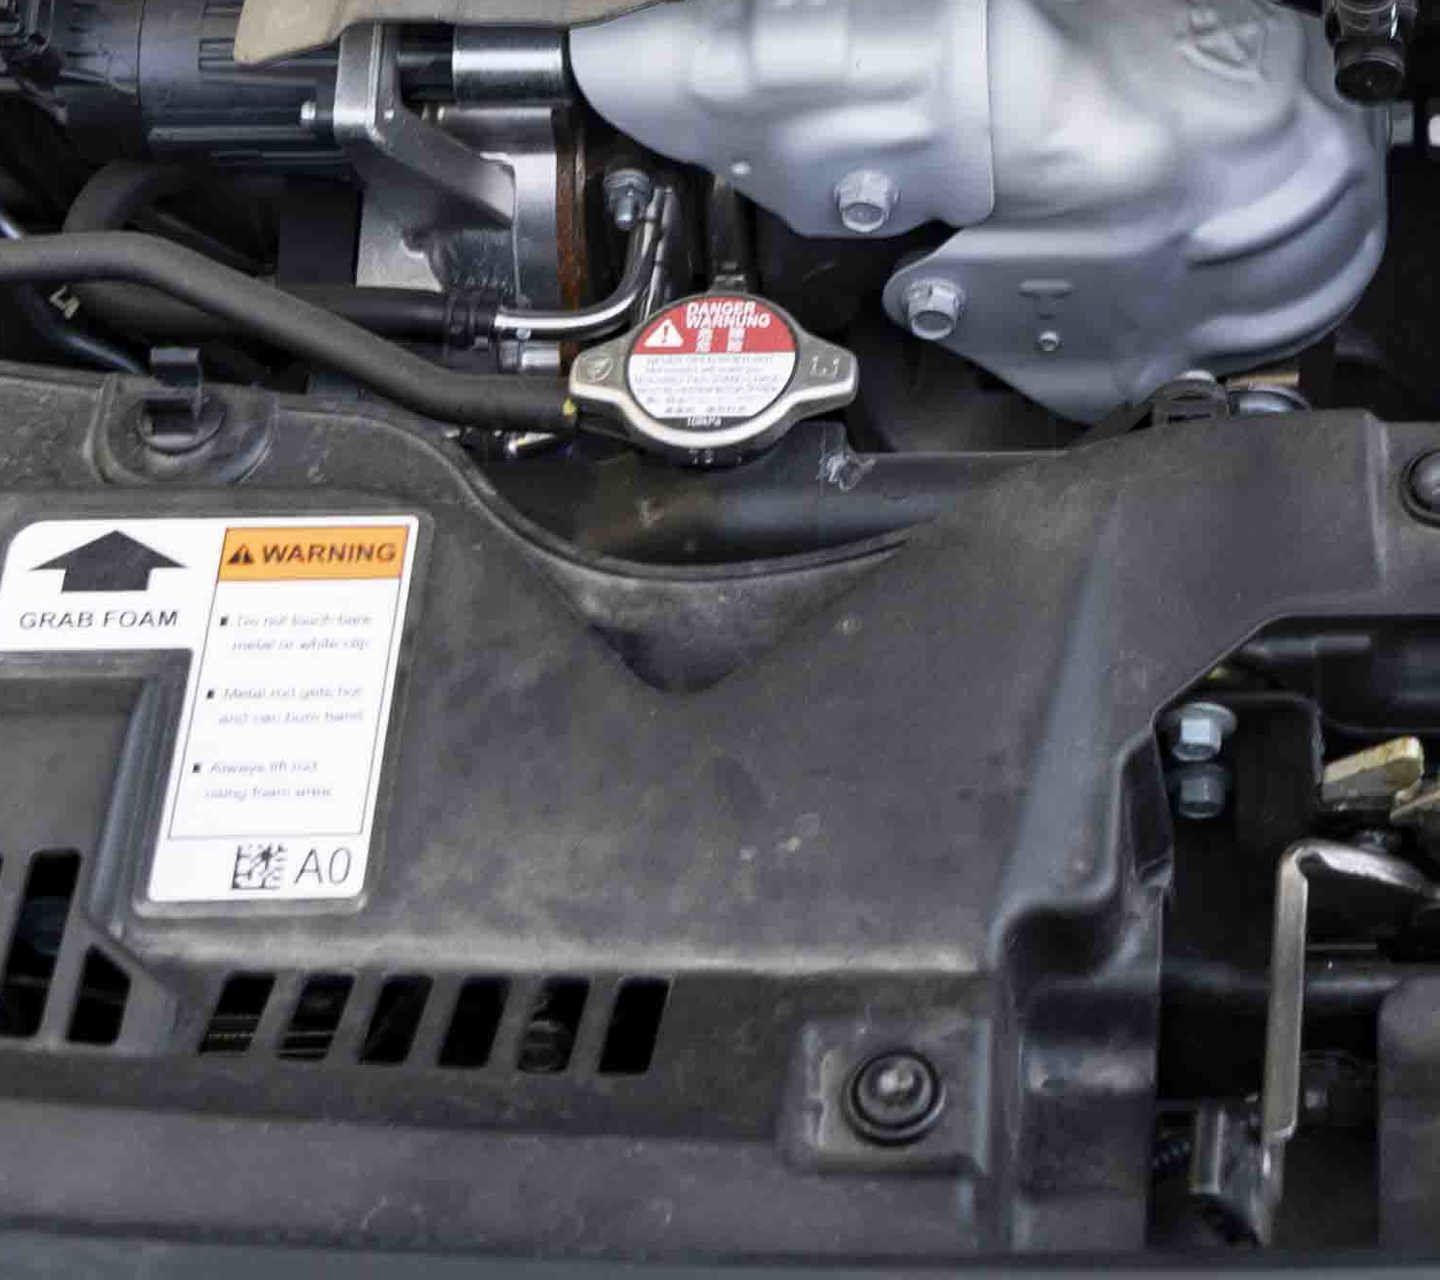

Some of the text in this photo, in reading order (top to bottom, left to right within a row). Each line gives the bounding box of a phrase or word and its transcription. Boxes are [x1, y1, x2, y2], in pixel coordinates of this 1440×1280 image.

[687, 301, 757, 315] DANGER
[686, 312, 772, 328] WARNUNG
[262, 541, 398, 566] WARNING
[19, 609, 181, 630] GRAB FOAM
[293, 846, 352, 886] A0
